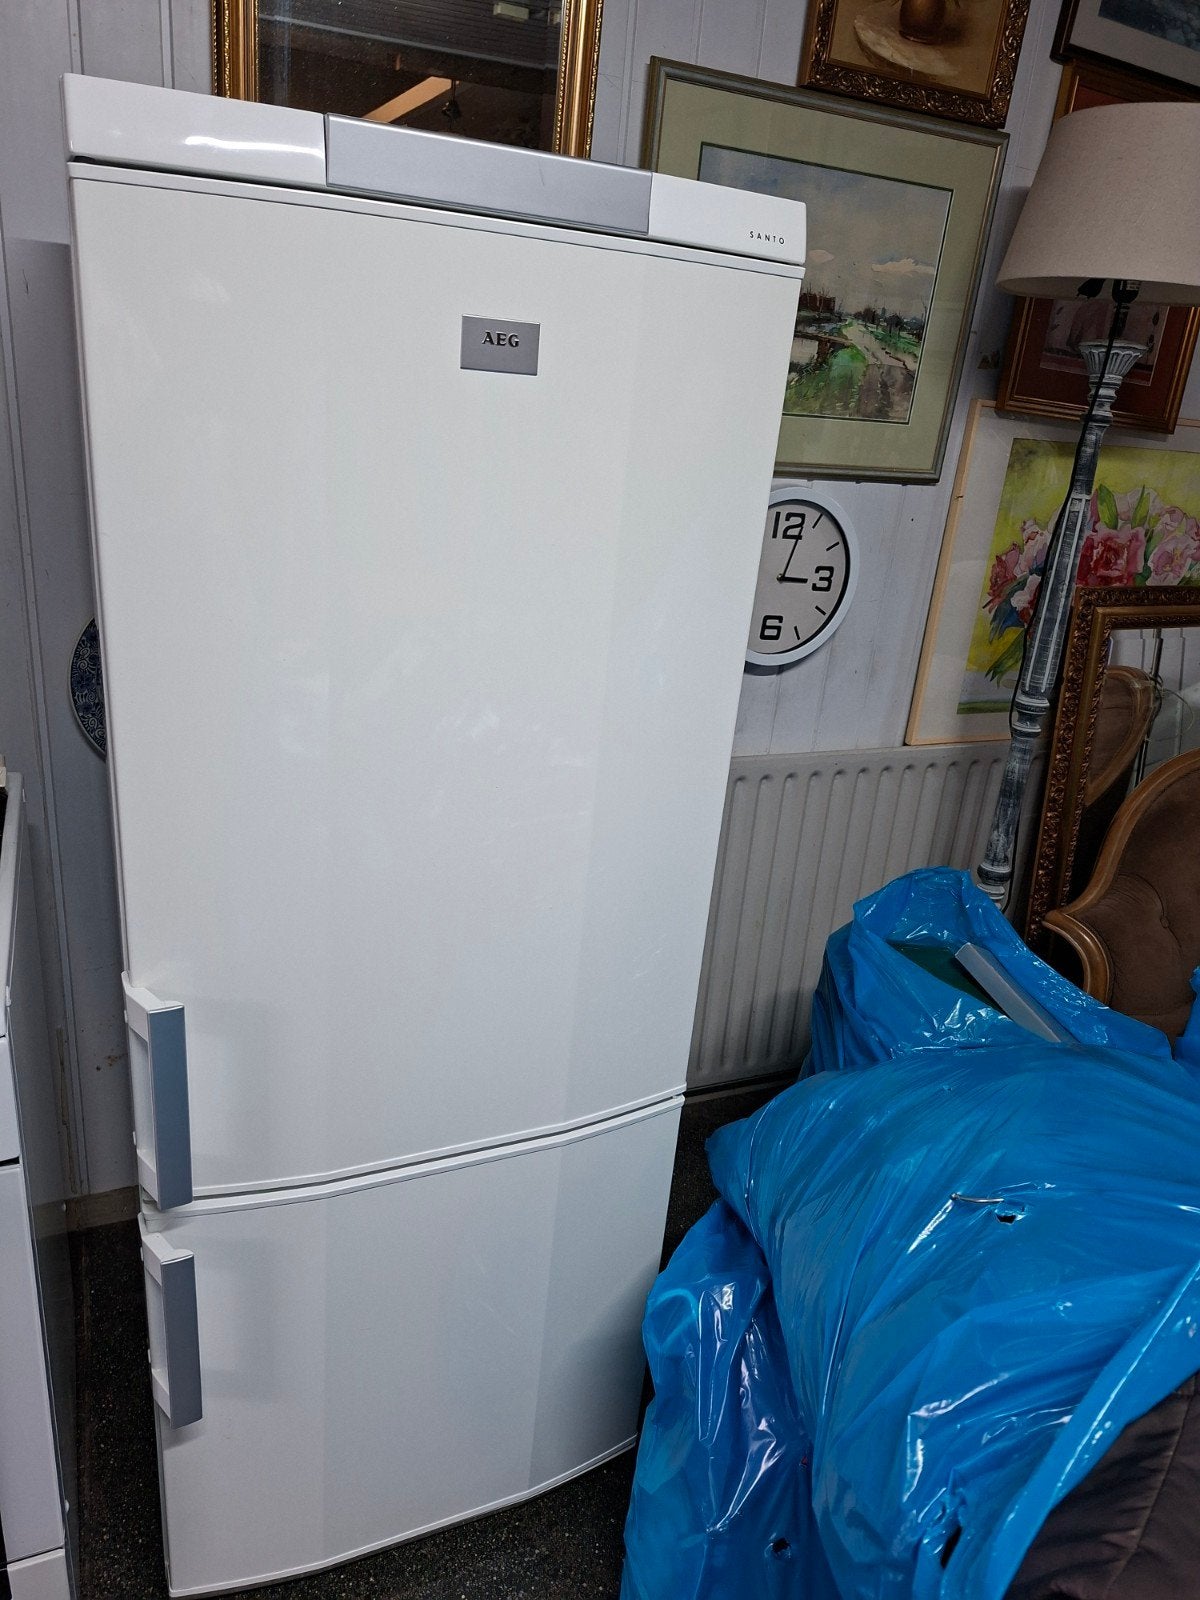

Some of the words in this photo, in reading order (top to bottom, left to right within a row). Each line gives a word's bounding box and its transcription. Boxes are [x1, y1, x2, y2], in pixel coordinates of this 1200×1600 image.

[749, 230, 785, 245] SANTO
[481, 330, 520, 348] AEG
[771, 511, 806, 541] 12
[811, 565, 835, 592] 3
[759, 614, 784, 641] 6
